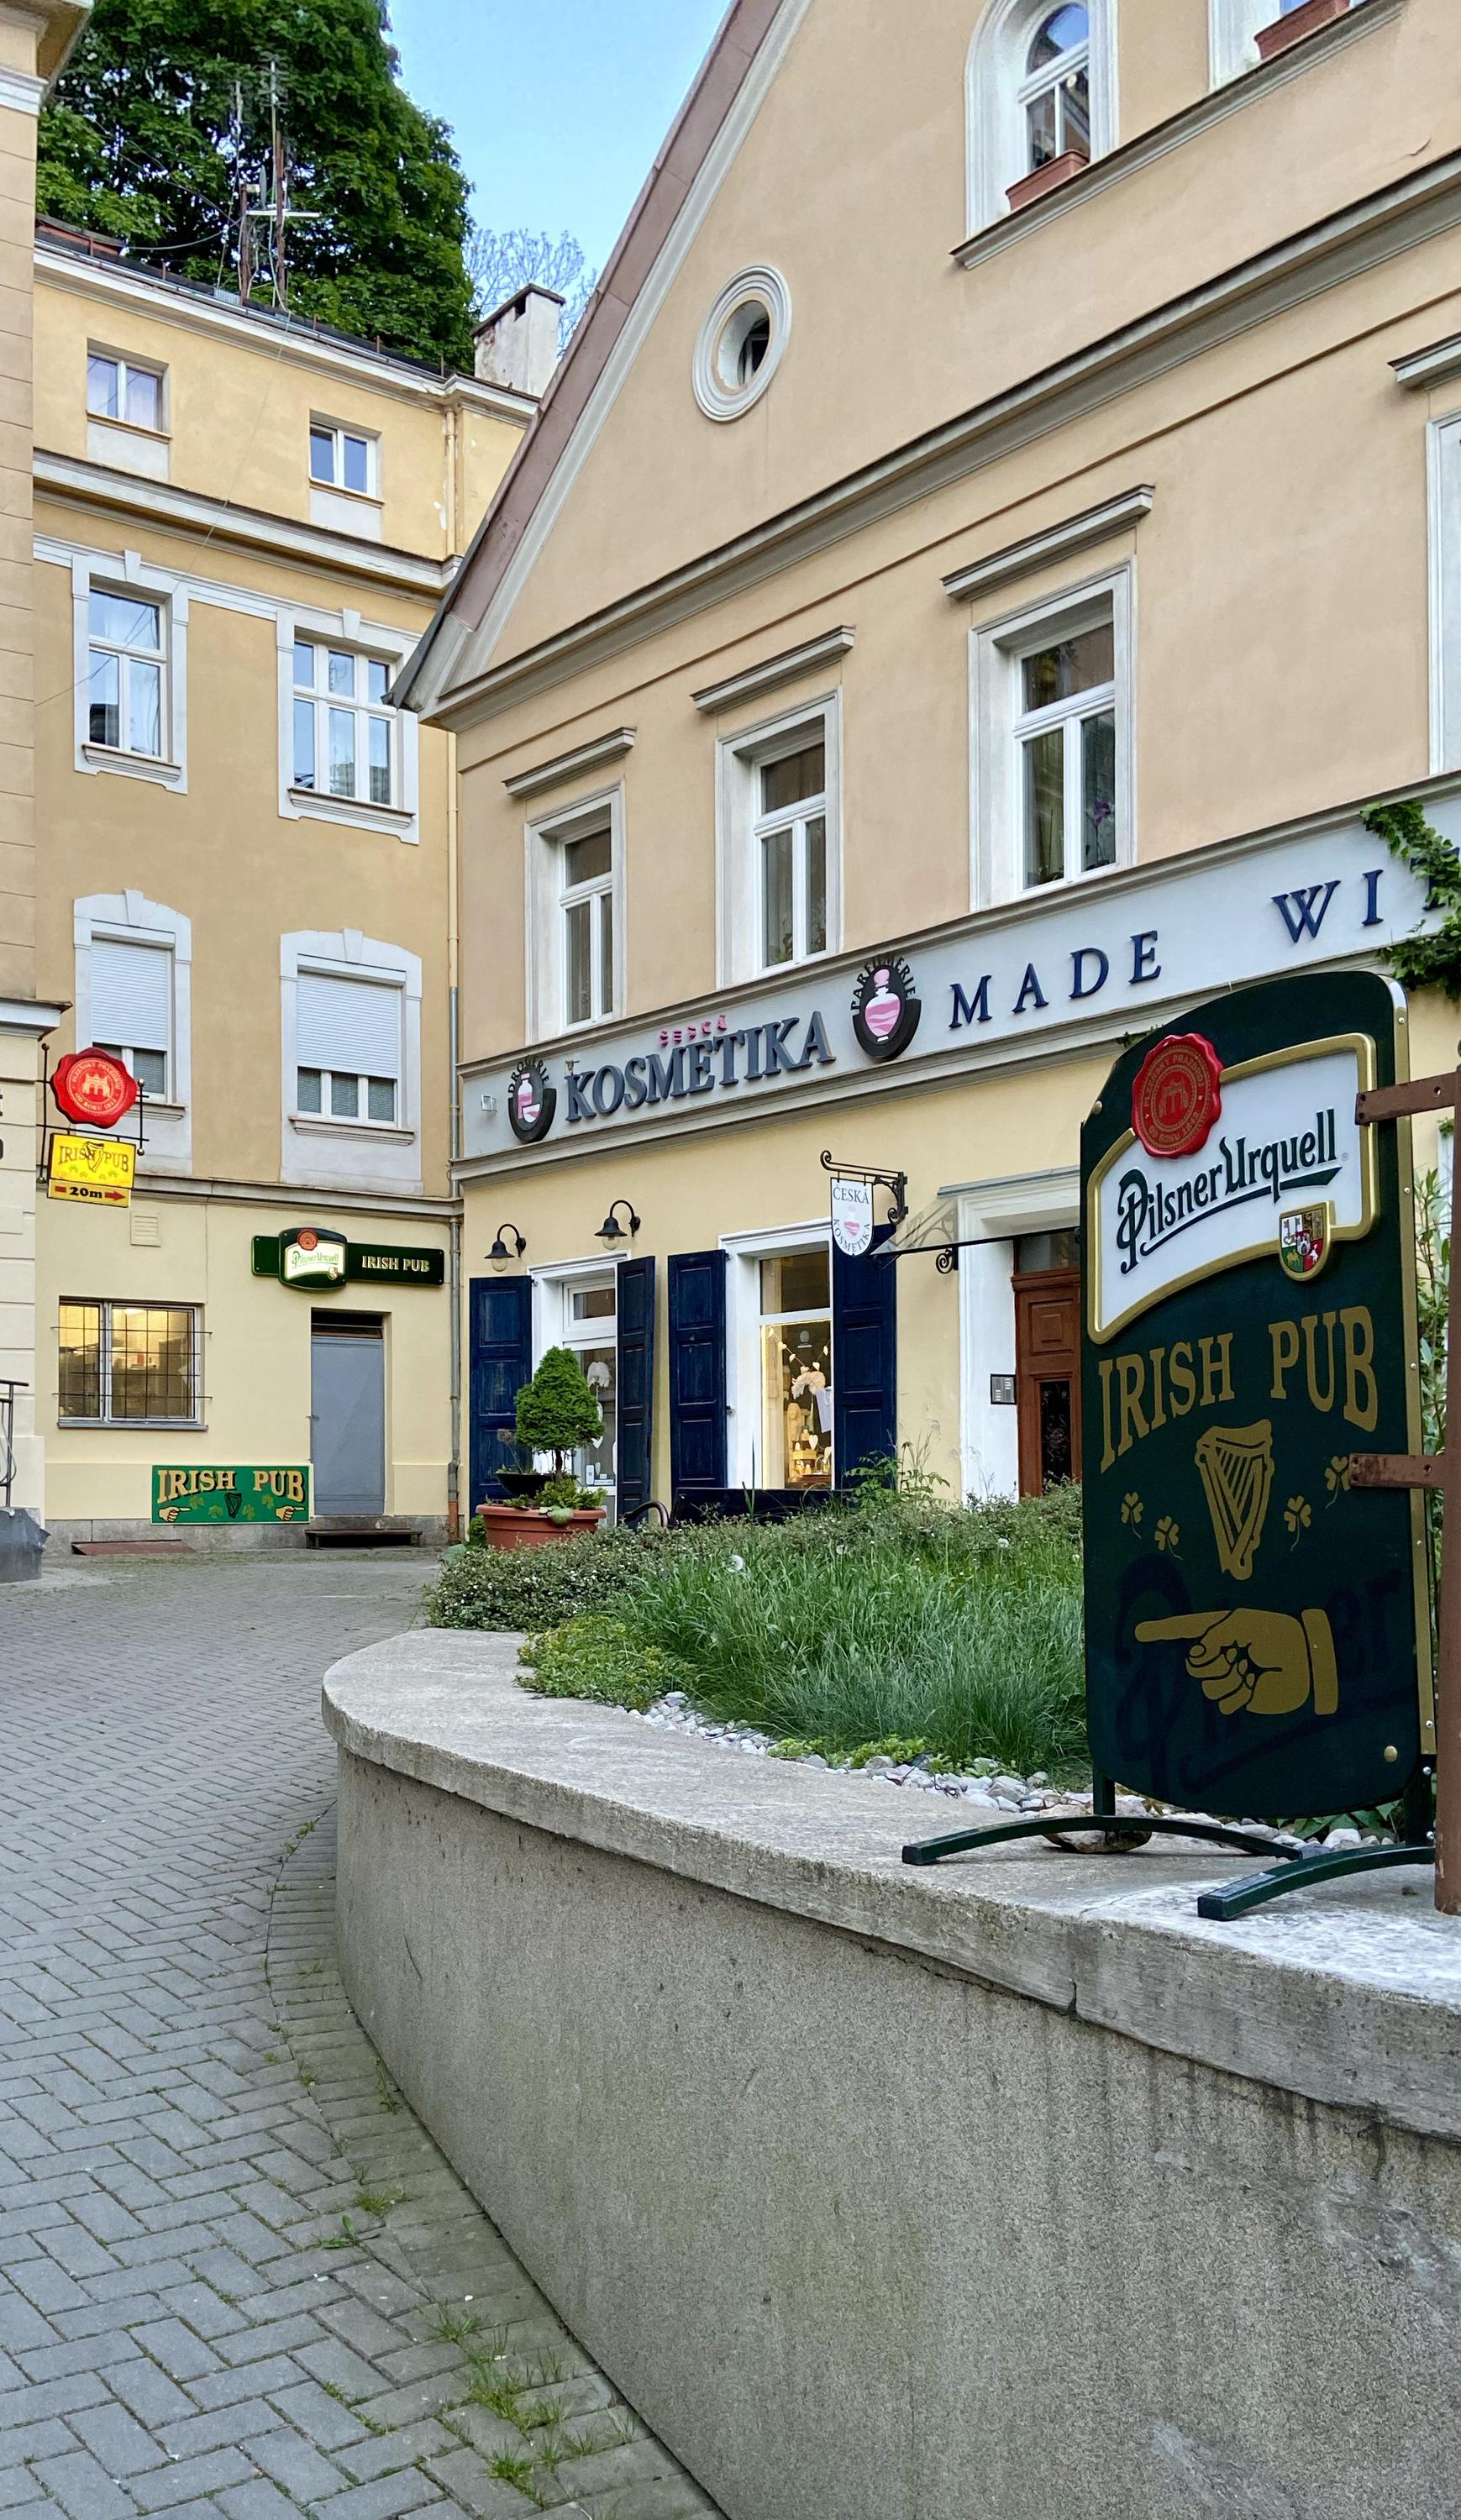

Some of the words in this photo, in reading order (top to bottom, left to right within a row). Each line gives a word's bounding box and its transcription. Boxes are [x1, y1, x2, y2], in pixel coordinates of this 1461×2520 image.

[948, 930, 1162, 1029] MADE
[564, 1011, 838, 1123] KOSMETIKA
[102, 1151, 129, 1173] PUB
[69, 1185, 102, 1199] 20m
[833, 1184, 870, 1205] ČESKÁ
[1116, 1168, 1223, 1275] Pilsner
[1219, 1108, 1337, 1205] Urquell
[833, 1218, 870, 1252] KOSMETIKA
[361, 1255, 399, 1271] IRISH
[402, 1258, 430, 1273] PUB
[1098, 1331, 1236, 1475] IRISH
[1268, 1305, 1379, 1433] PUB
[157, 1469, 236, 1504] IRISH
[253, 1470, 304, 1503] PUB
